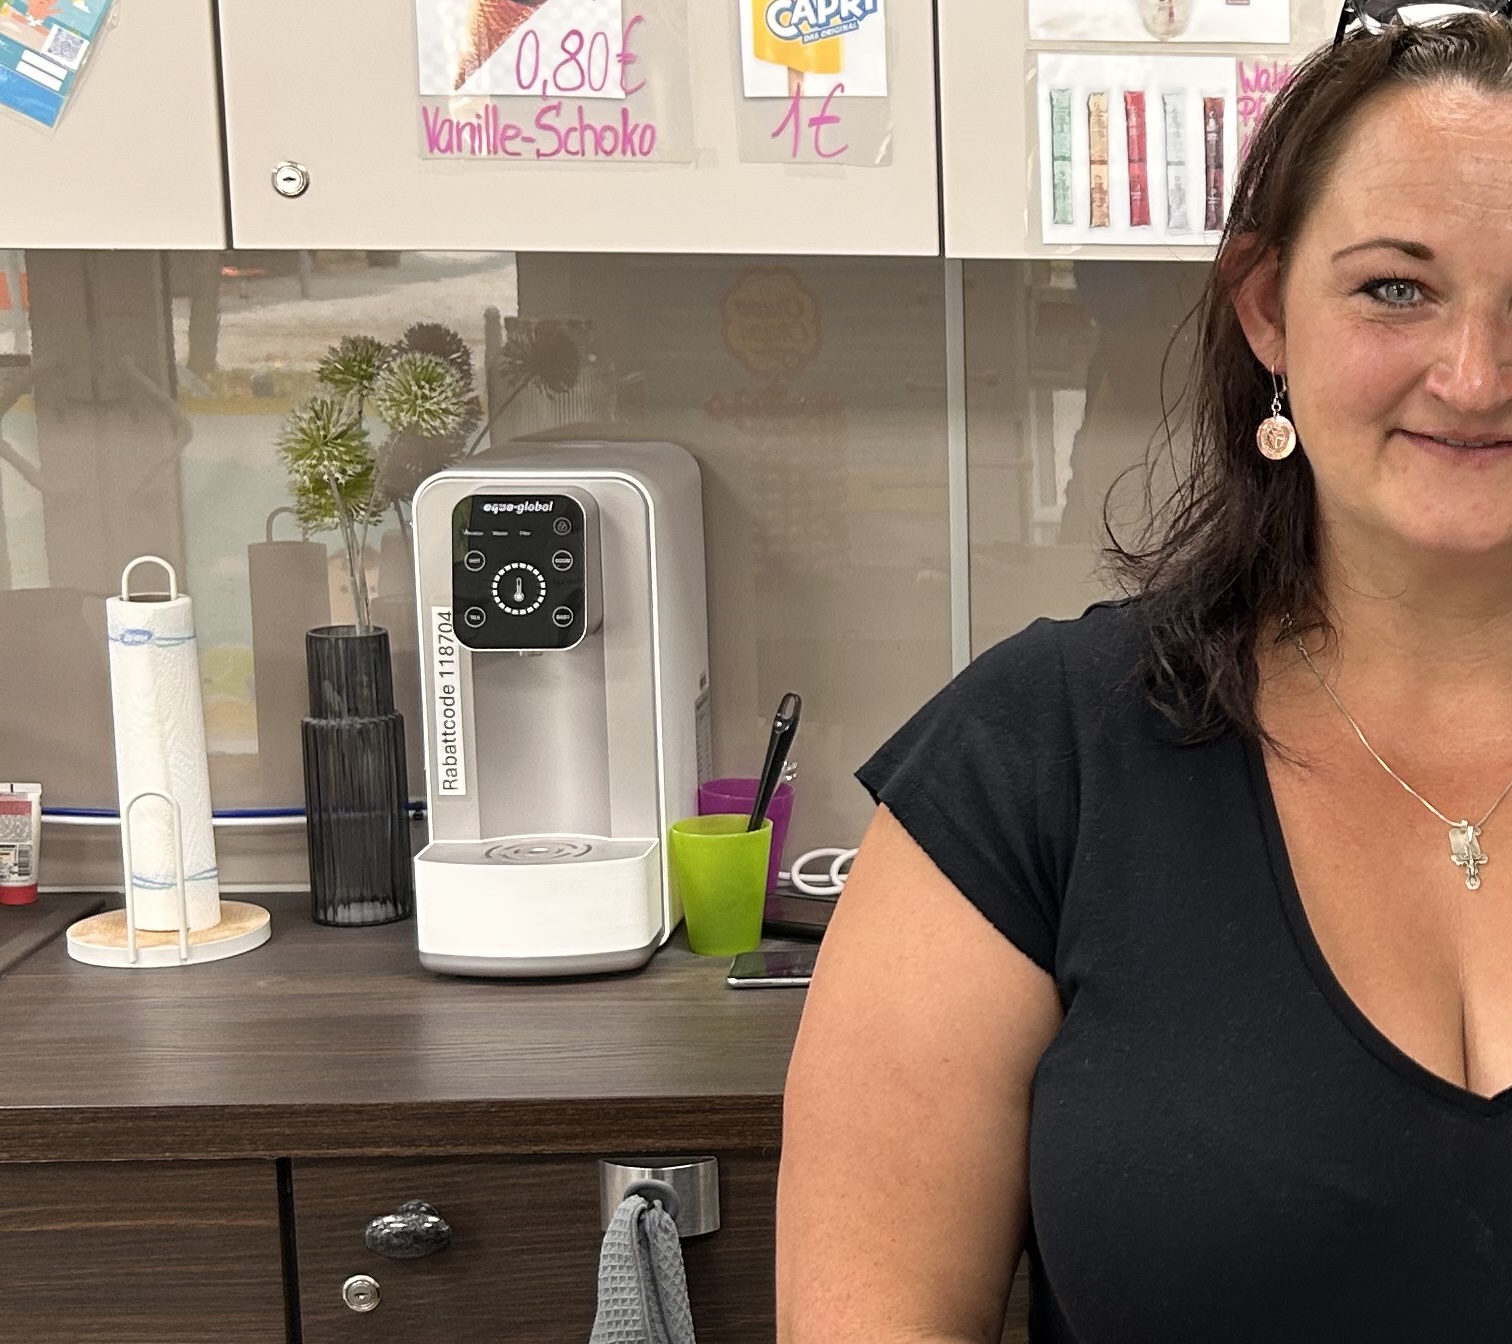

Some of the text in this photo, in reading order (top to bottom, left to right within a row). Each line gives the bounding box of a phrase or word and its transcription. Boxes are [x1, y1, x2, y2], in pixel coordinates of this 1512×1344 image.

[422, 102, 658, 159] Vanille-Schoko
[437, 610, 459, 791] Rabattcode 118704
